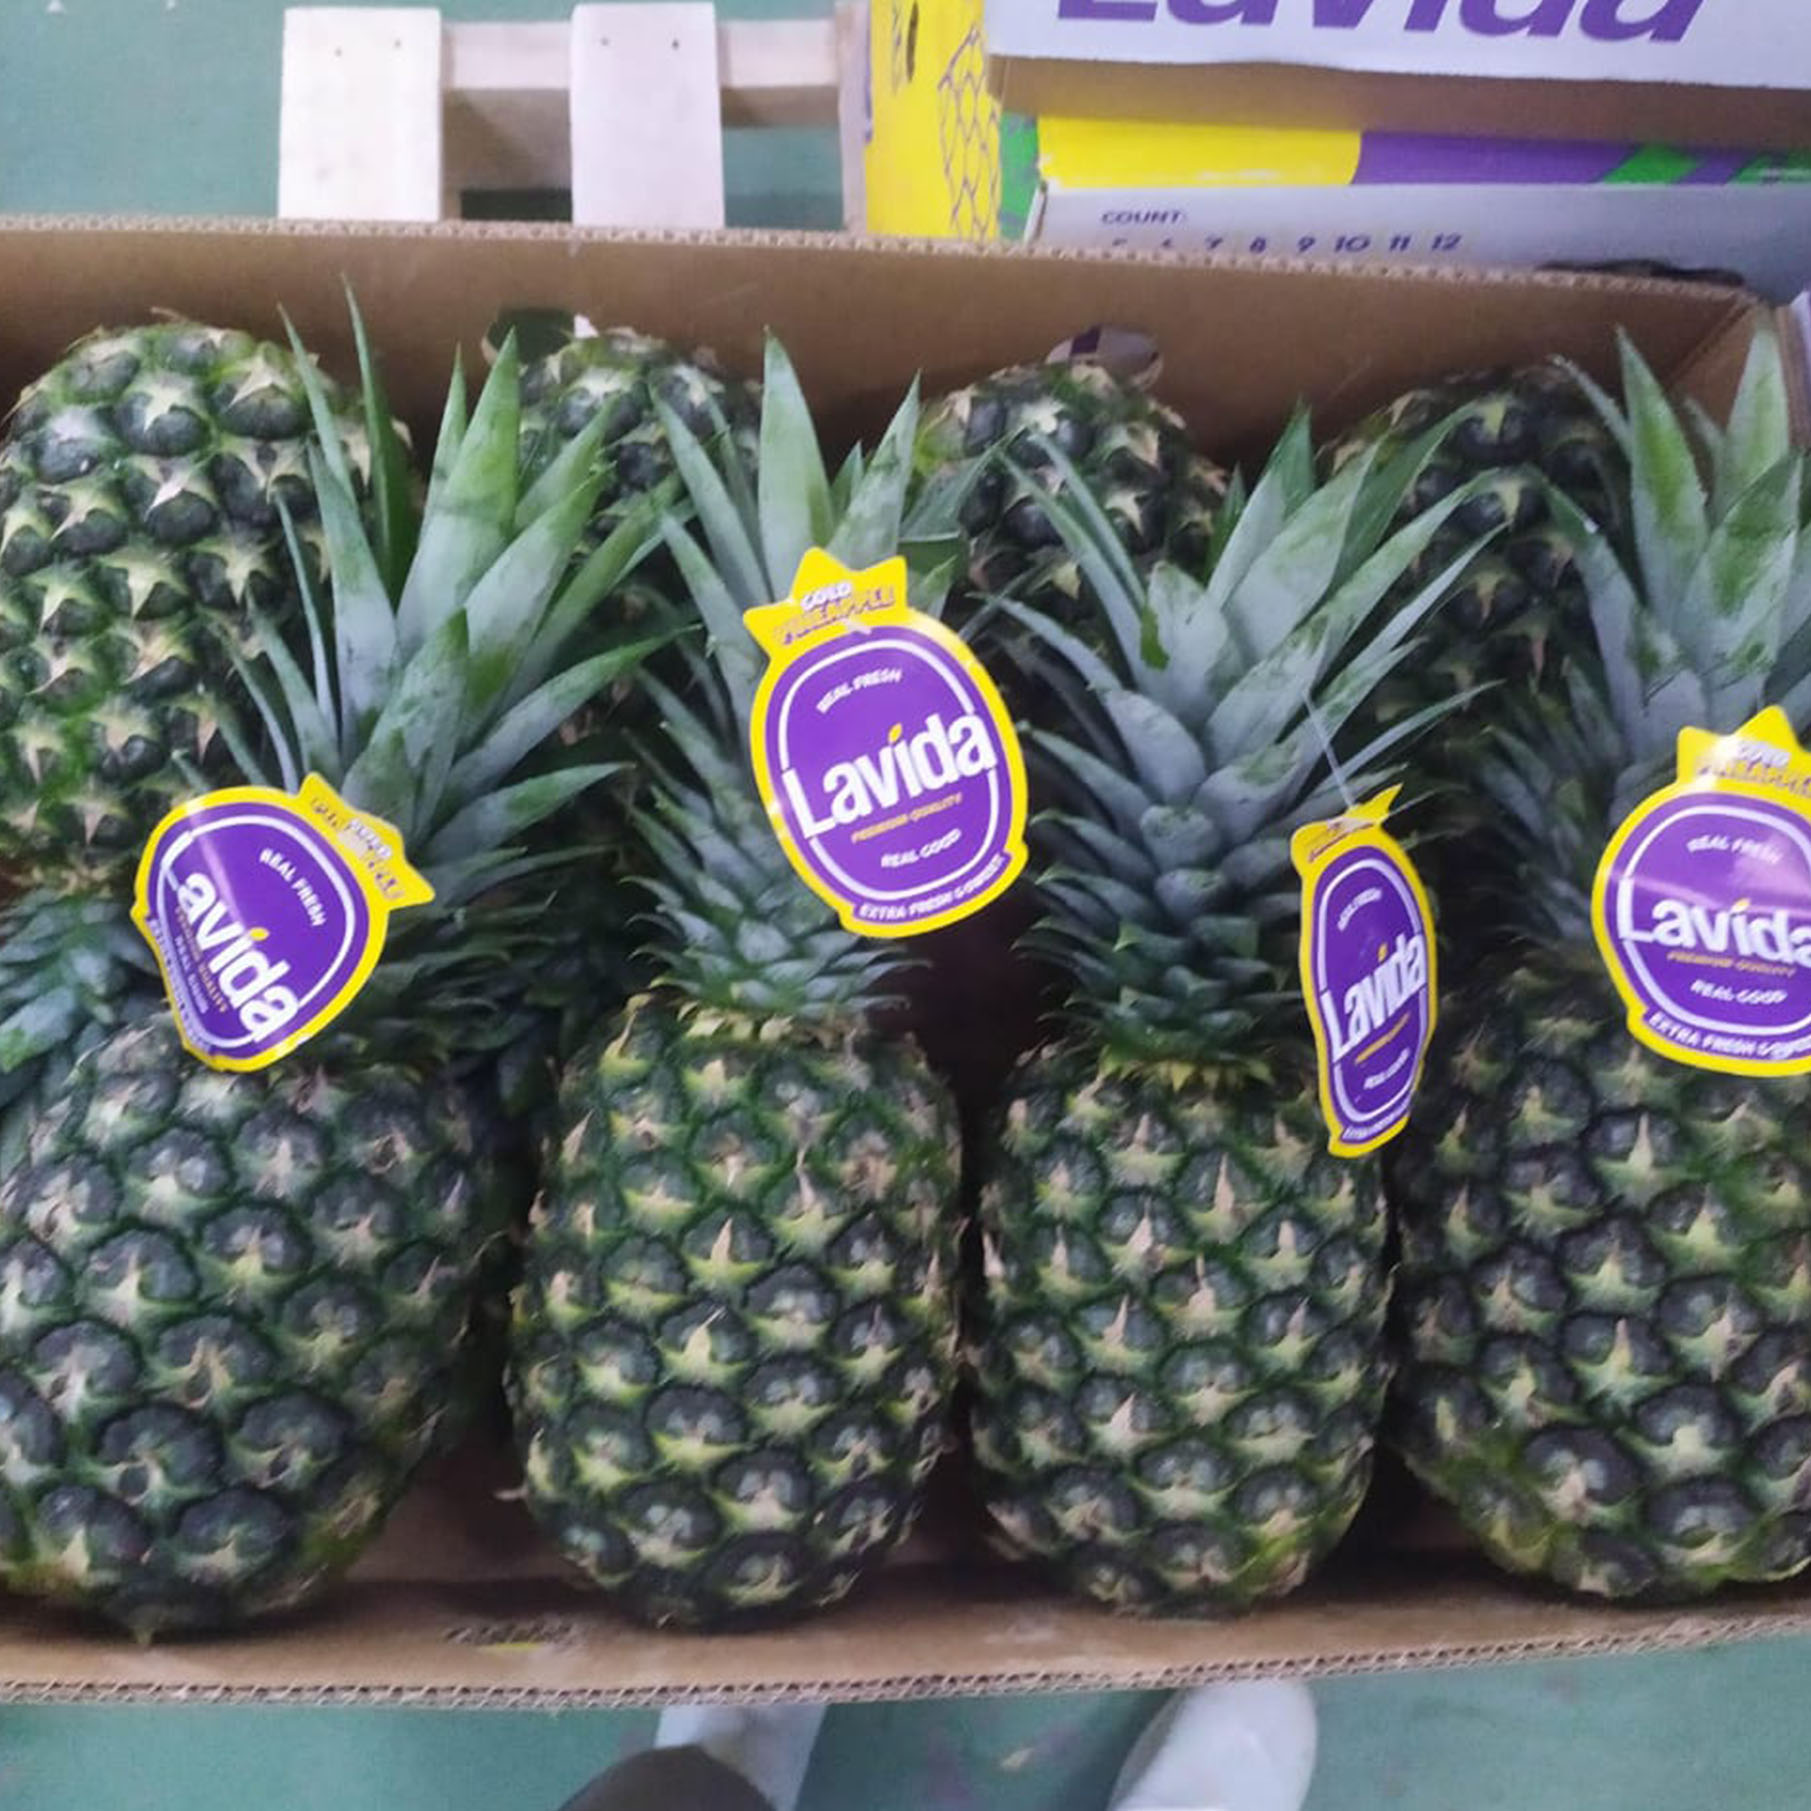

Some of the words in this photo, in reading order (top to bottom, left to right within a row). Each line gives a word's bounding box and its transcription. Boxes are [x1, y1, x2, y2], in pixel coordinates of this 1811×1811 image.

[1249, 236, 1267, 253] 8
[1335, 235, 1371, 252] 10
[1389, 235, 1411, 251] 11
[1431, 233, 1462, 251] 12
[782, 713, 998, 840] Lavida
[1320, 932, 1427, 1064] Lavida
